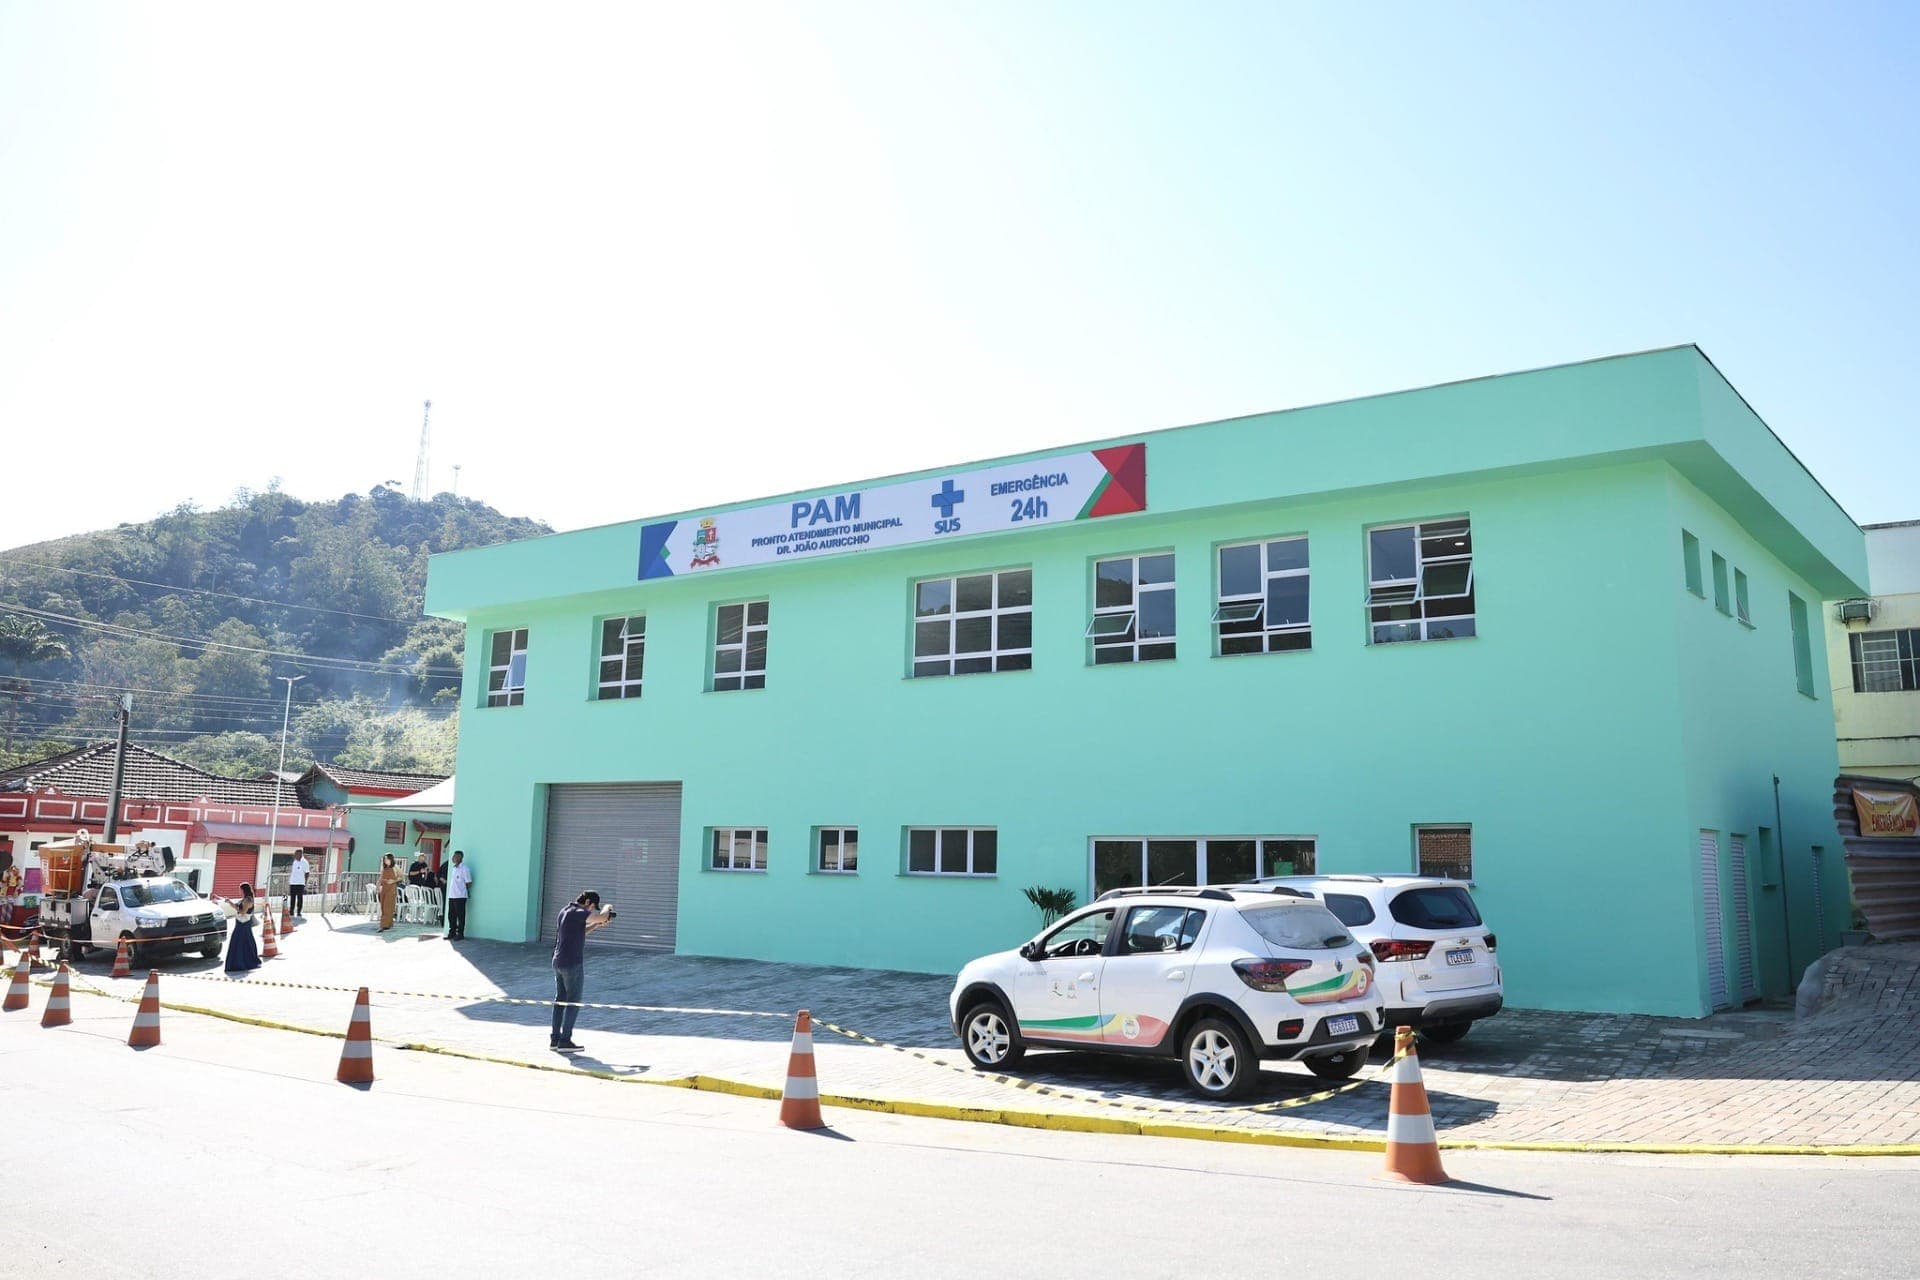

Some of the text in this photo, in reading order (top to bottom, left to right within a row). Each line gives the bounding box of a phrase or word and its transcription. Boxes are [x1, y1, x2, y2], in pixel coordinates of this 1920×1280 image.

[991, 472, 1069, 496] EMERGÊNCIA
[791, 493, 861, 529] PAM
[1010, 496, 1049, 522] 24h
[751, 517, 903, 547] PRONTO ATENDIMENTO MUNICIPAL
[934, 518, 961, 535] SUS
[776, 534, 870, 555] DR. JOÃO AURICCHIO
